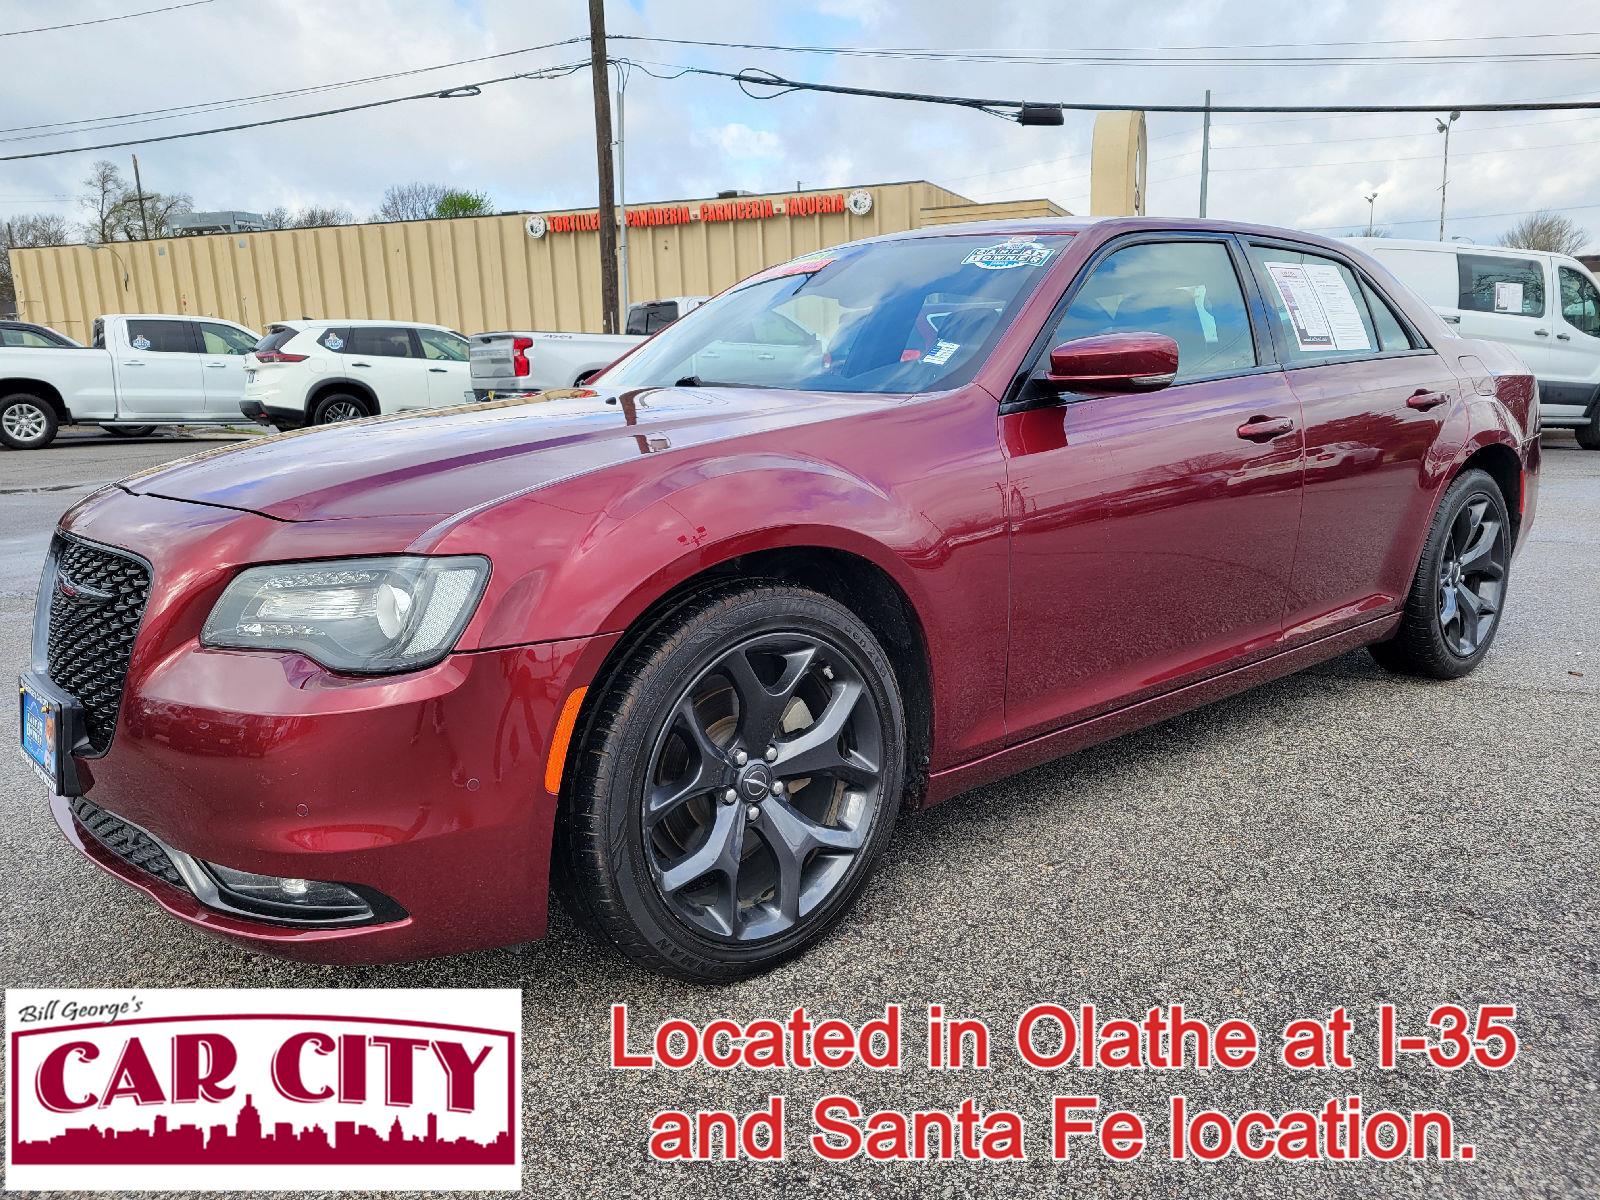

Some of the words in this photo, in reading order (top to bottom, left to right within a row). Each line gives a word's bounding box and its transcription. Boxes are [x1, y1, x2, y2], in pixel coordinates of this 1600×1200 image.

[625, 206, 690, 228] PANADERIA
[699, 199, 774, 222] CARNICERIA
[783, 193, 845, 217] TAQUERIA
